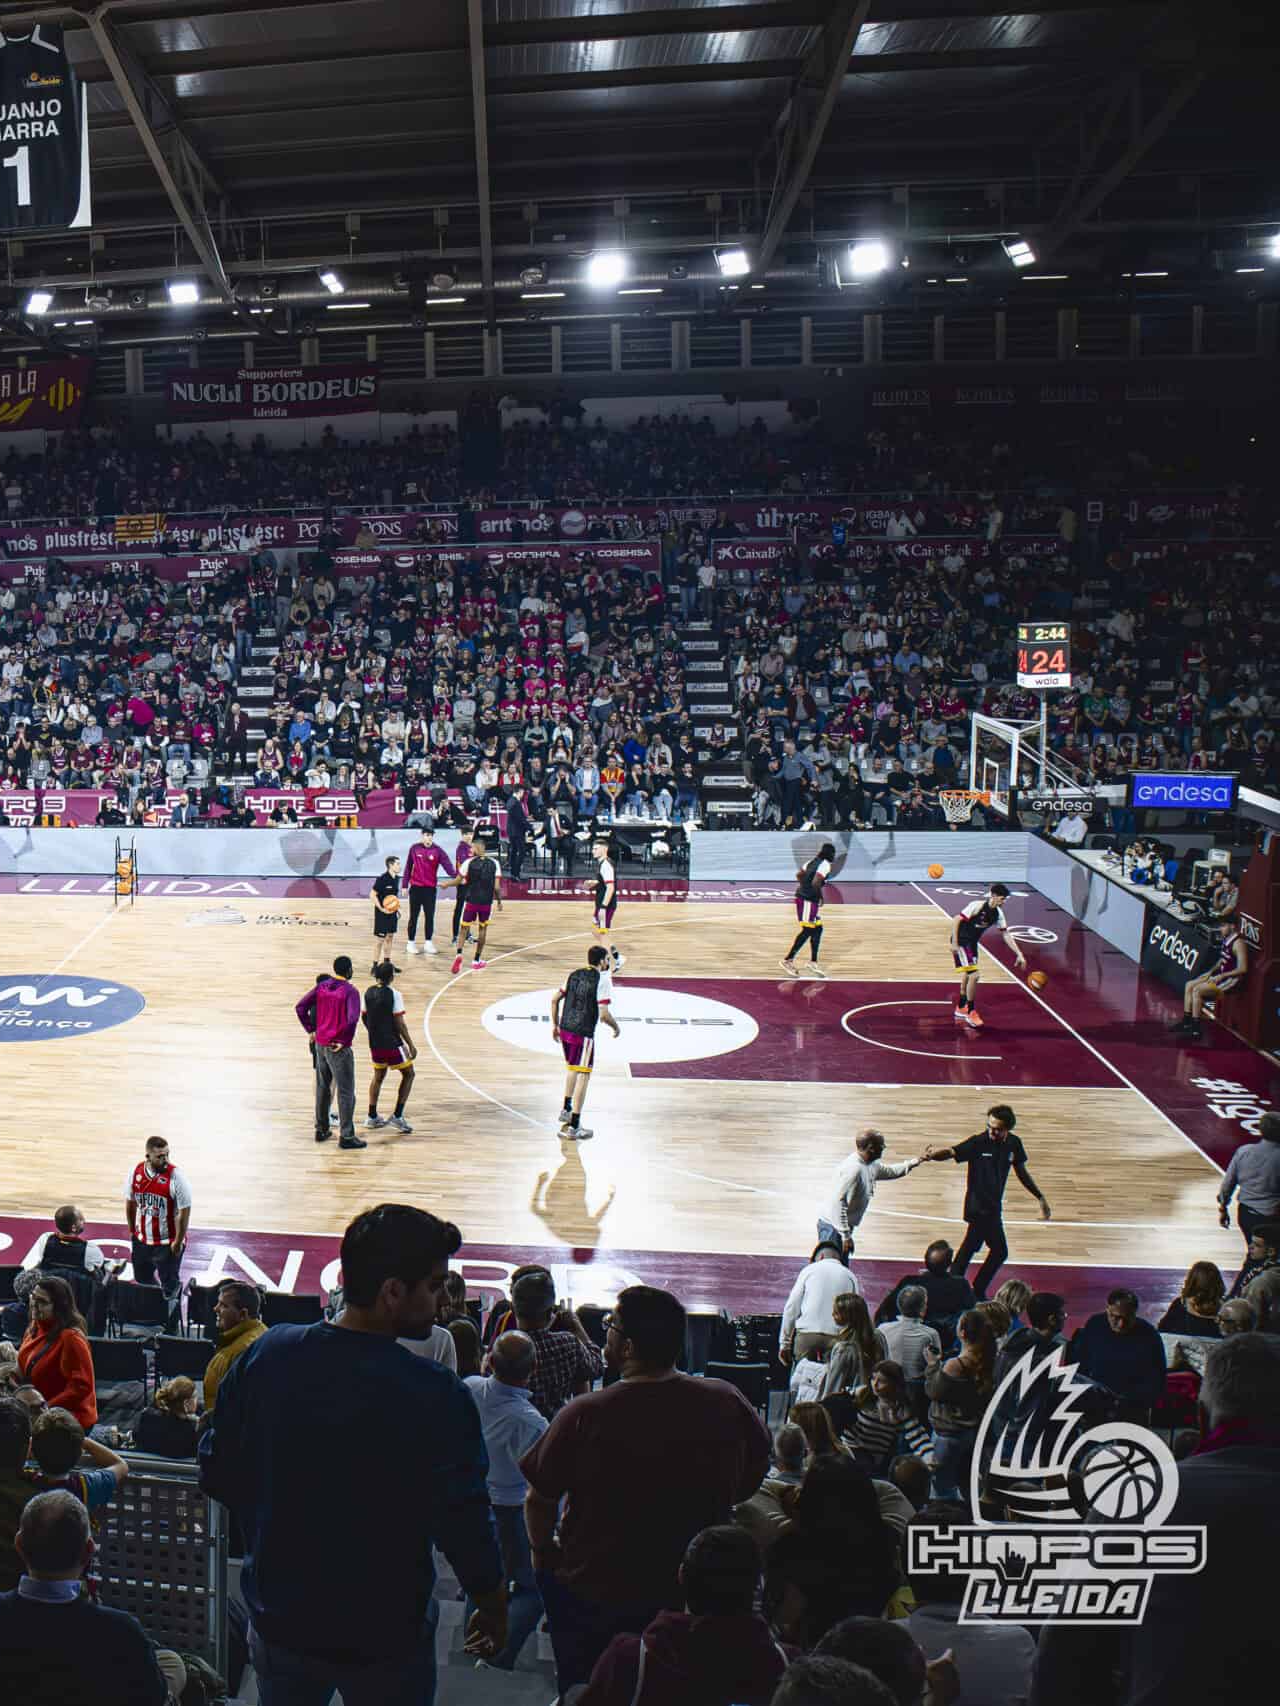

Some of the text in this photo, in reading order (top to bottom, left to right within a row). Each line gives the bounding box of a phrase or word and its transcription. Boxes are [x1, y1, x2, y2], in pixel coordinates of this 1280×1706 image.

[3, 146, 31, 206] 1
[1, 373, 12, 397] A
[17, 370, 38, 395] LA
[237, 369, 302, 380] Supporters
[253, 376, 376, 403] BORDEUS
[1034, 627, 1066, 640] 2:44
[1031, 650, 1066, 674] 24
[1138, 784, 1229, 802] endesa
[1032, 799, 1093, 812] endesa
[20, 879, 261, 896] LLEIDA
[1150, 925, 1199, 971] endesa
